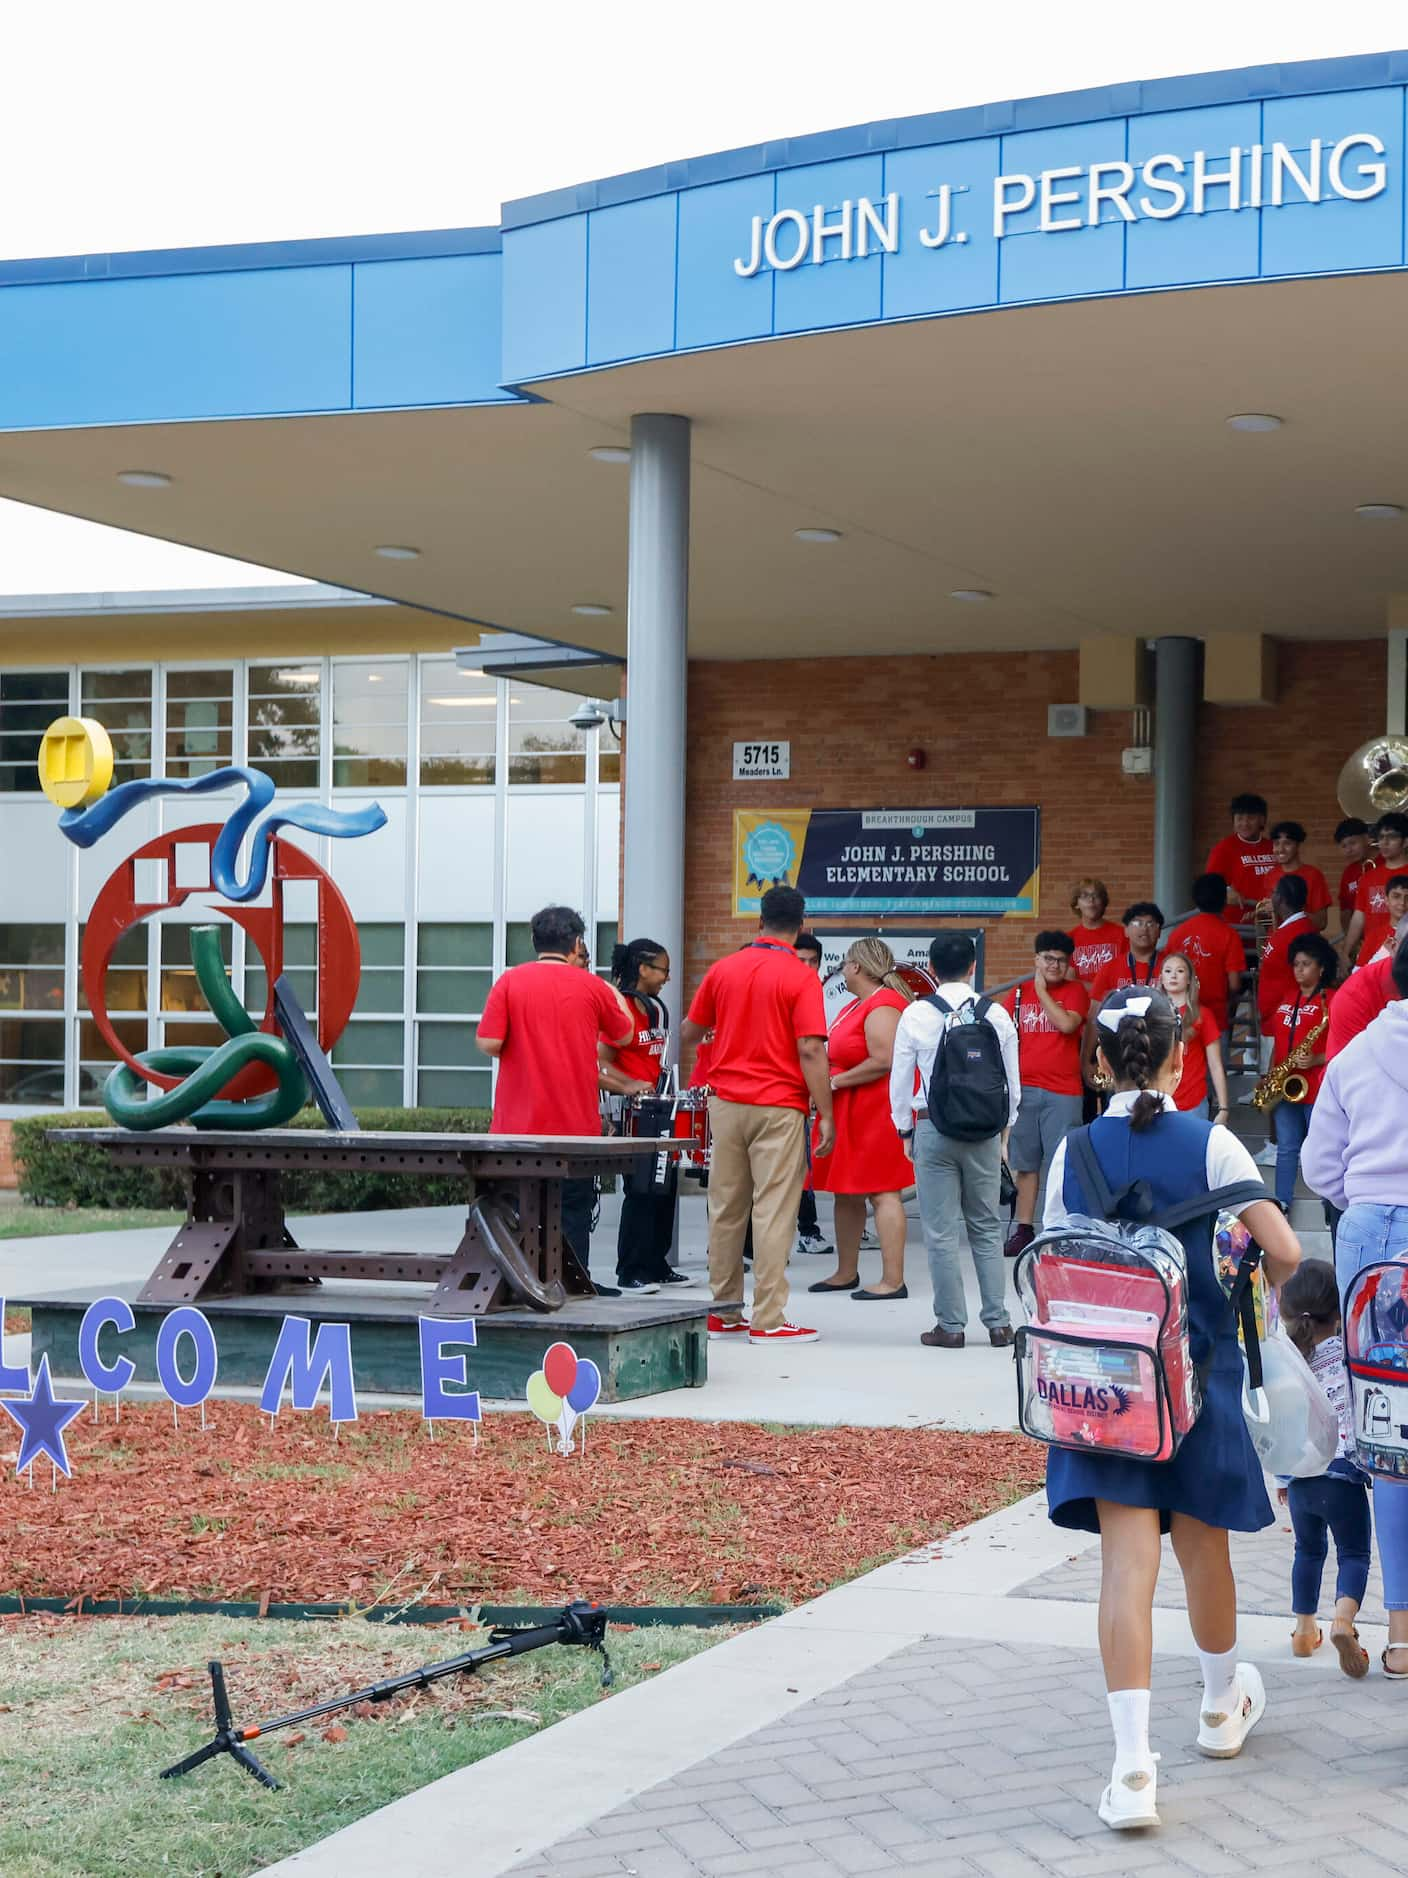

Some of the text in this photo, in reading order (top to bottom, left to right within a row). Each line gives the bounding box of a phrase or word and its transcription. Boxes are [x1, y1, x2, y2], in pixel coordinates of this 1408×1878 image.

[733, 192, 900, 278] JOHN
[918, 184, 969, 249] J.
[992, 132, 1388, 239] PERSHING
[744, 745, 779, 764] 5715
[739, 767, 770, 776] Meaders
[865, 813, 973, 825] BREAKTHROUGH CAMPUS
[841, 845, 995, 862] JOHN J. PERSHING
[826, 865, 1009, 883] ELEMENTARY SCHOOL
[1037, 1378, 1108, 1412] DALLAS
